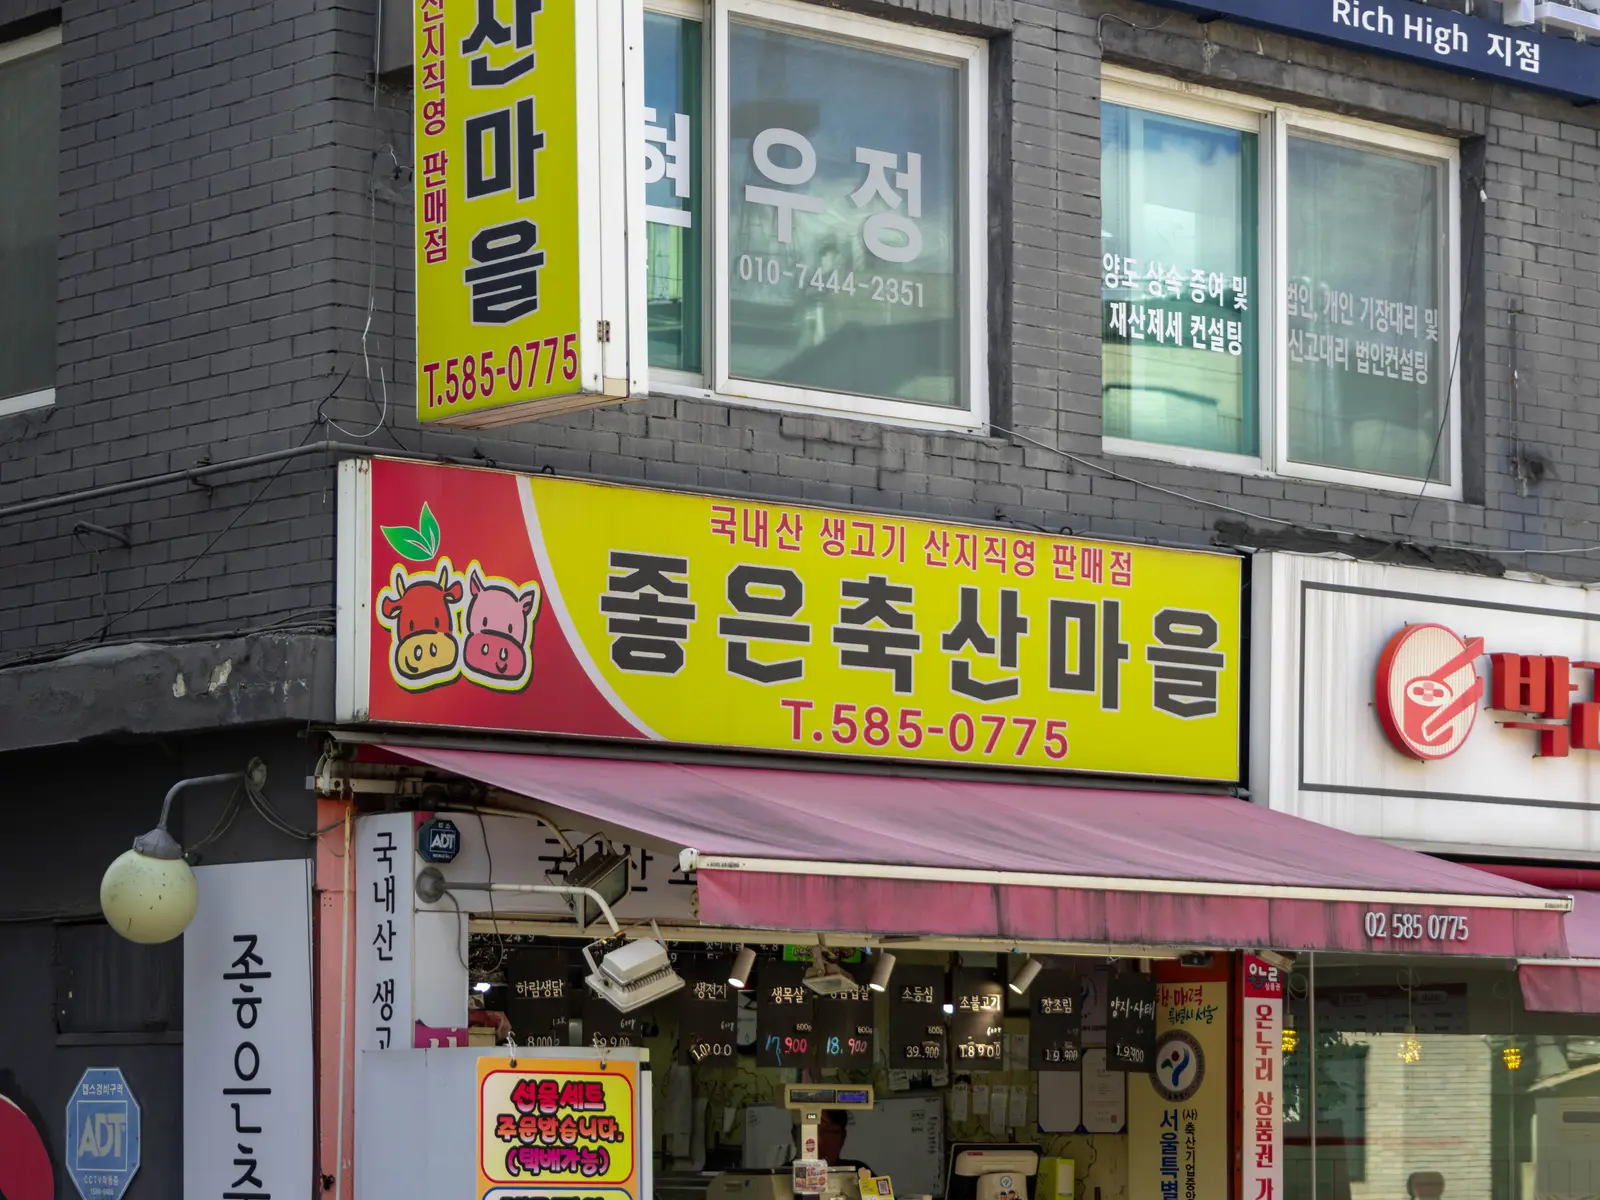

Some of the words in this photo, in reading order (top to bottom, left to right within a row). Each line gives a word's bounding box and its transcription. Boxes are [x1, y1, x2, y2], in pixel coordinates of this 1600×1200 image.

[1332, 0, 1394, 36] Rich
[1404, 13, 1469, 55] High
[1486, 33, 1541, 74] 지점
[423, 150, 448, 264] 판매점
[739, 254, 924, 308] 010-7444-2351
[1102, 253, 1140, 289] 양도
[1146, 261, 1183, 300] 상속
[1189, 268, 1224, 307] 증여
[1232, 276, 1248, 311] 및
[1109, 302, 1182, 346] 재산제세
[1190, 314, 1243, 356] 컨설팅
[1323, 290, 1355, 326] 개인
[1360, 297, 1418, 338] 기장대리
[423, 333, 578, 409] T.585-0775
[1288, 329, 1349, 371] 신고대리
[1355, 340, 1429, 385] 법인컨설팅
[709, 504, 803, 553] 국내산
[819, 516, 906, 565] 생고기
[923, 528, 1036, 579] 산지직영
[1051, 542, 1133, 587] 판매점
[600, 550, 1225, 719] 좋은축산마을
[780, 699, 1069, 760] T.585-0775
[430, 833, 456, 849] ADT
[373, 832, 397, 961] 국내산
[1365, 911, 1387, 937] 02
[1392, 913, 1423, 939] 585
[1427, 914, 1469, 941] 0775
[515, 979, 565, 998] 하림생닭
[693, 982, 728, 1000] 생전지
[770, 986, 804, 1004] 생목살
[901, 985, 933, 1004] 소등심
[959, 993, 1001, 1012] 소불고기
[1040, 996, 1072, 1014] 장조림
[1255, 1004, 1274, 1081] 온누리
[510, 1079, 606, 1114] 선물세트
[78, 1113, 127, 1158] ADT
[495, 1114, 624, 1145] 주문받습니다.
[1255, 1091, 1274, 1168] 상품권
[505, 1145, 611, 1177] (택배가능)
